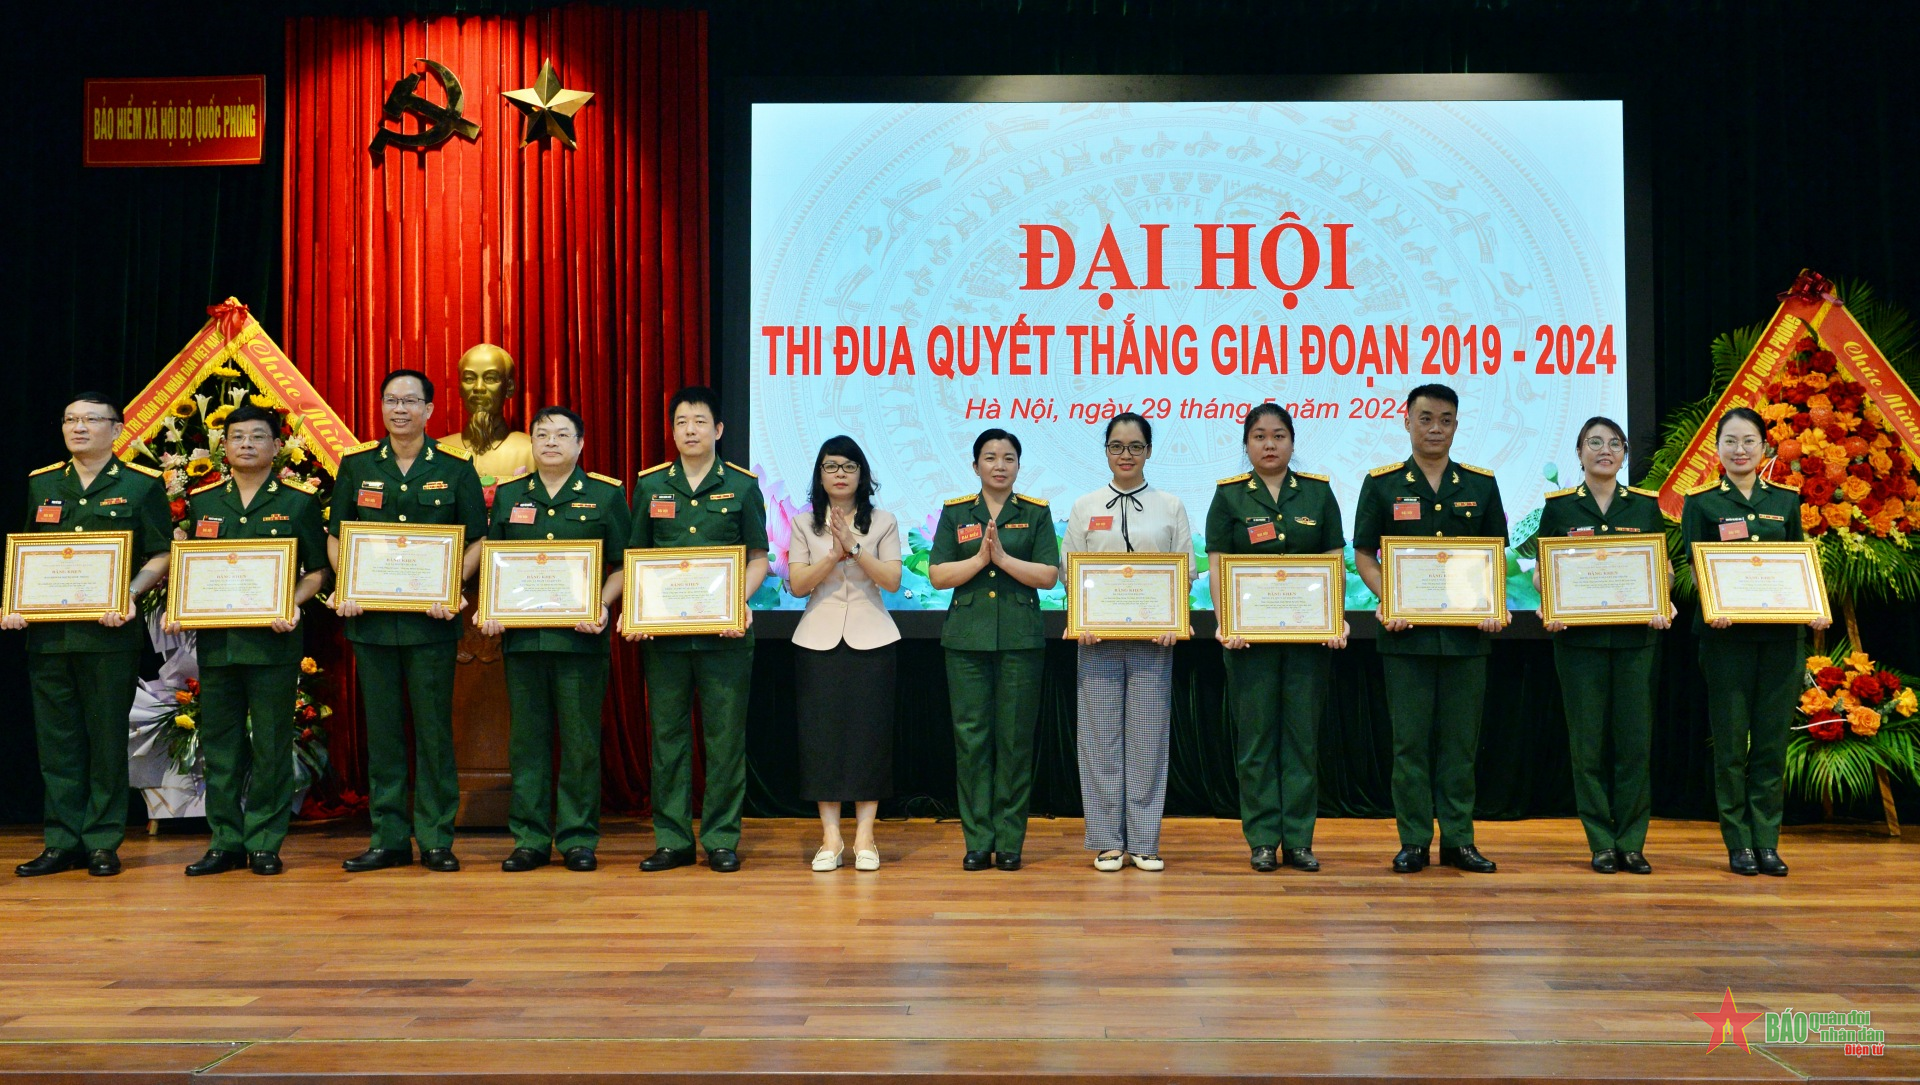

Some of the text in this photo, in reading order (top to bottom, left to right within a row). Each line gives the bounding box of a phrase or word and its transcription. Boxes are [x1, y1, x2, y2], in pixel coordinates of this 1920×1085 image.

[94, 94, 256, 147] BẢO HIỂM XÃ HỘI BỘ QUỐC PHÒNG
[1019, 212, 1355, 310] ĐẠI HỘI
[762, 314, 1616, 387] THI ĐUA QUYẾT THẮNG GIAI ĐOẠN 2019 - 2024
[1769, 314, 1802, 346] PHÒNG
[1742, 373, 1764, 393] BỘ
[1752, 346, 1780, 377] QUỐC
[1844, 341, 1882, 389] Chúc
[125, 417, 145, 433] TRỊ
[137, 401, 160, 423] QUÂN
[153, 390, 170, 406] ĐỘI
[164, 375, 187, 395] NHÂN
[180, 358, 198, 377] DÂN
[192, 344, 210, 362] VIỆT
[248, 339, 344, 459] Chúc Mừn
[965, 398, 1000, 419] Hà
[1010, 398, 1057, 423] Nội,
[1141, 398, 1172, 419] 29
[1180, 398, 1252, 424] tháng
[1286, 398, 1338, 419] năm
[1349, 397, 1408, 419] 2024
[1672, 466, 1700, 496] QUÂN
